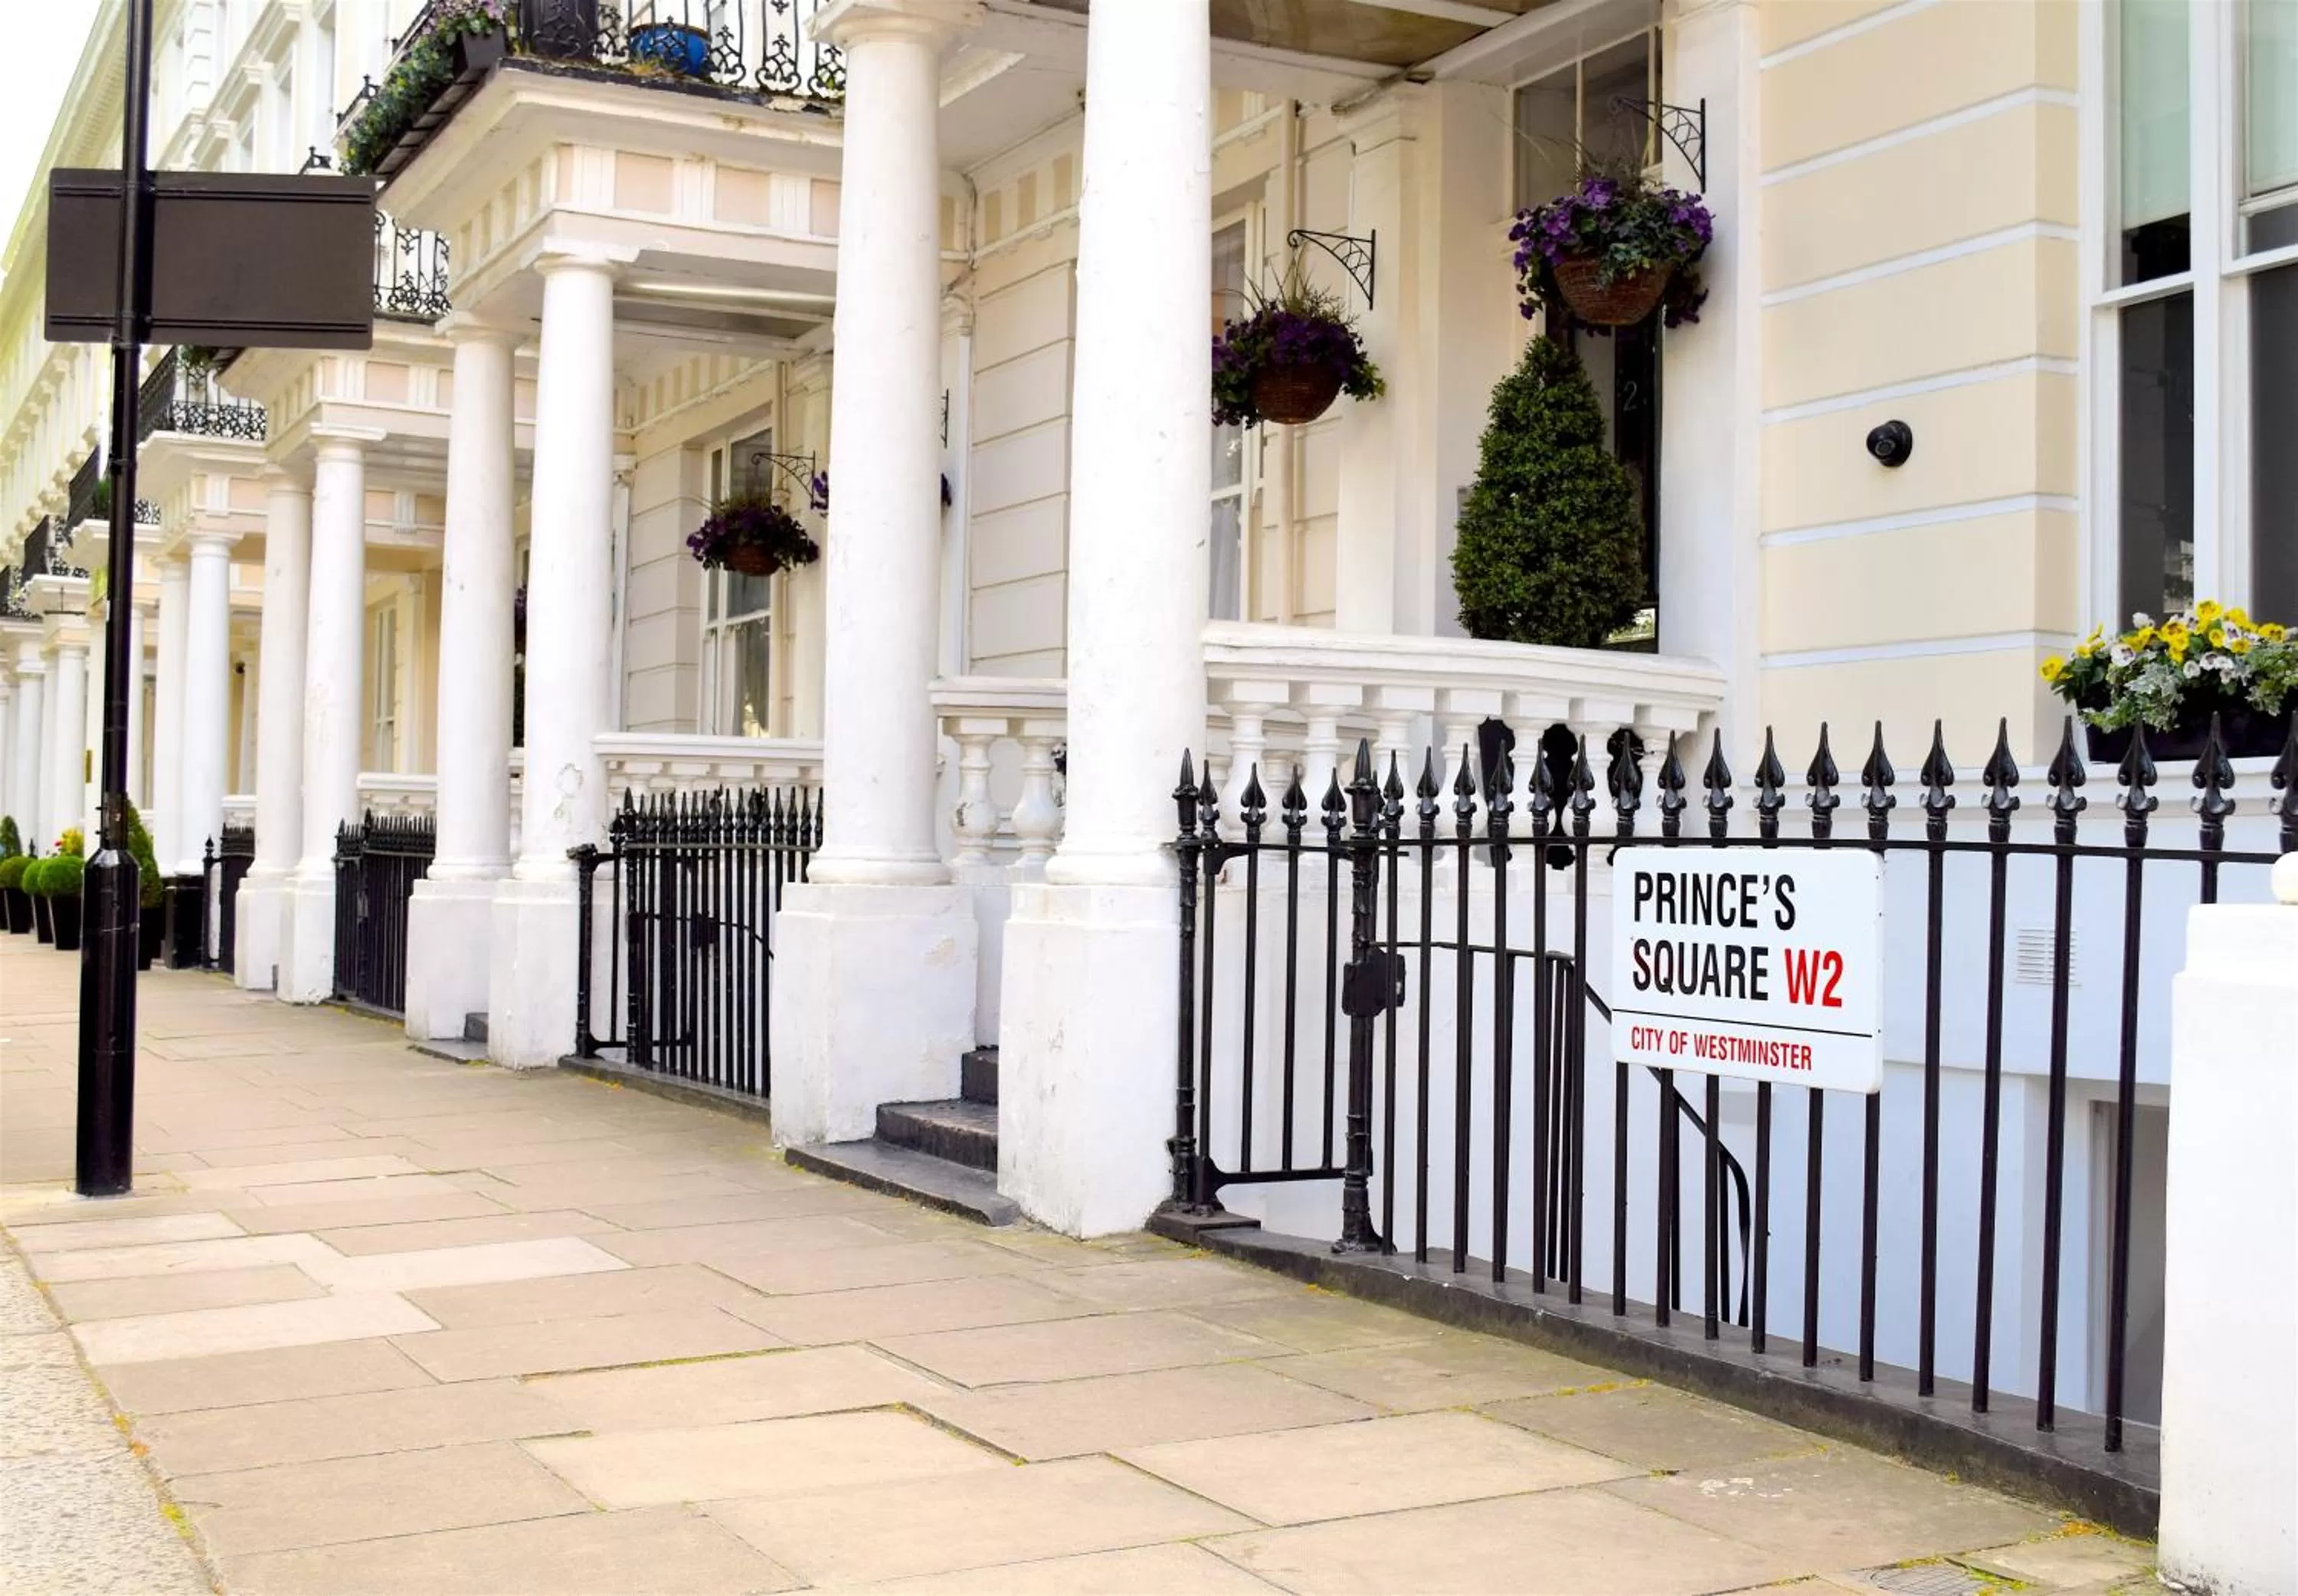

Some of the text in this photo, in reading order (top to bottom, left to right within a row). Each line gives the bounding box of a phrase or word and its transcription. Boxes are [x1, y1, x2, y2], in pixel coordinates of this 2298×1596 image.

[1623, 380, 1638, 413] 2
[1634, 871, 1796, 931] PRINCE'S
[1632, 938, 1844, 1008] SQUARE W2
[1631, 1026, 1812, 1071] CITY OF WESTMINSTER
